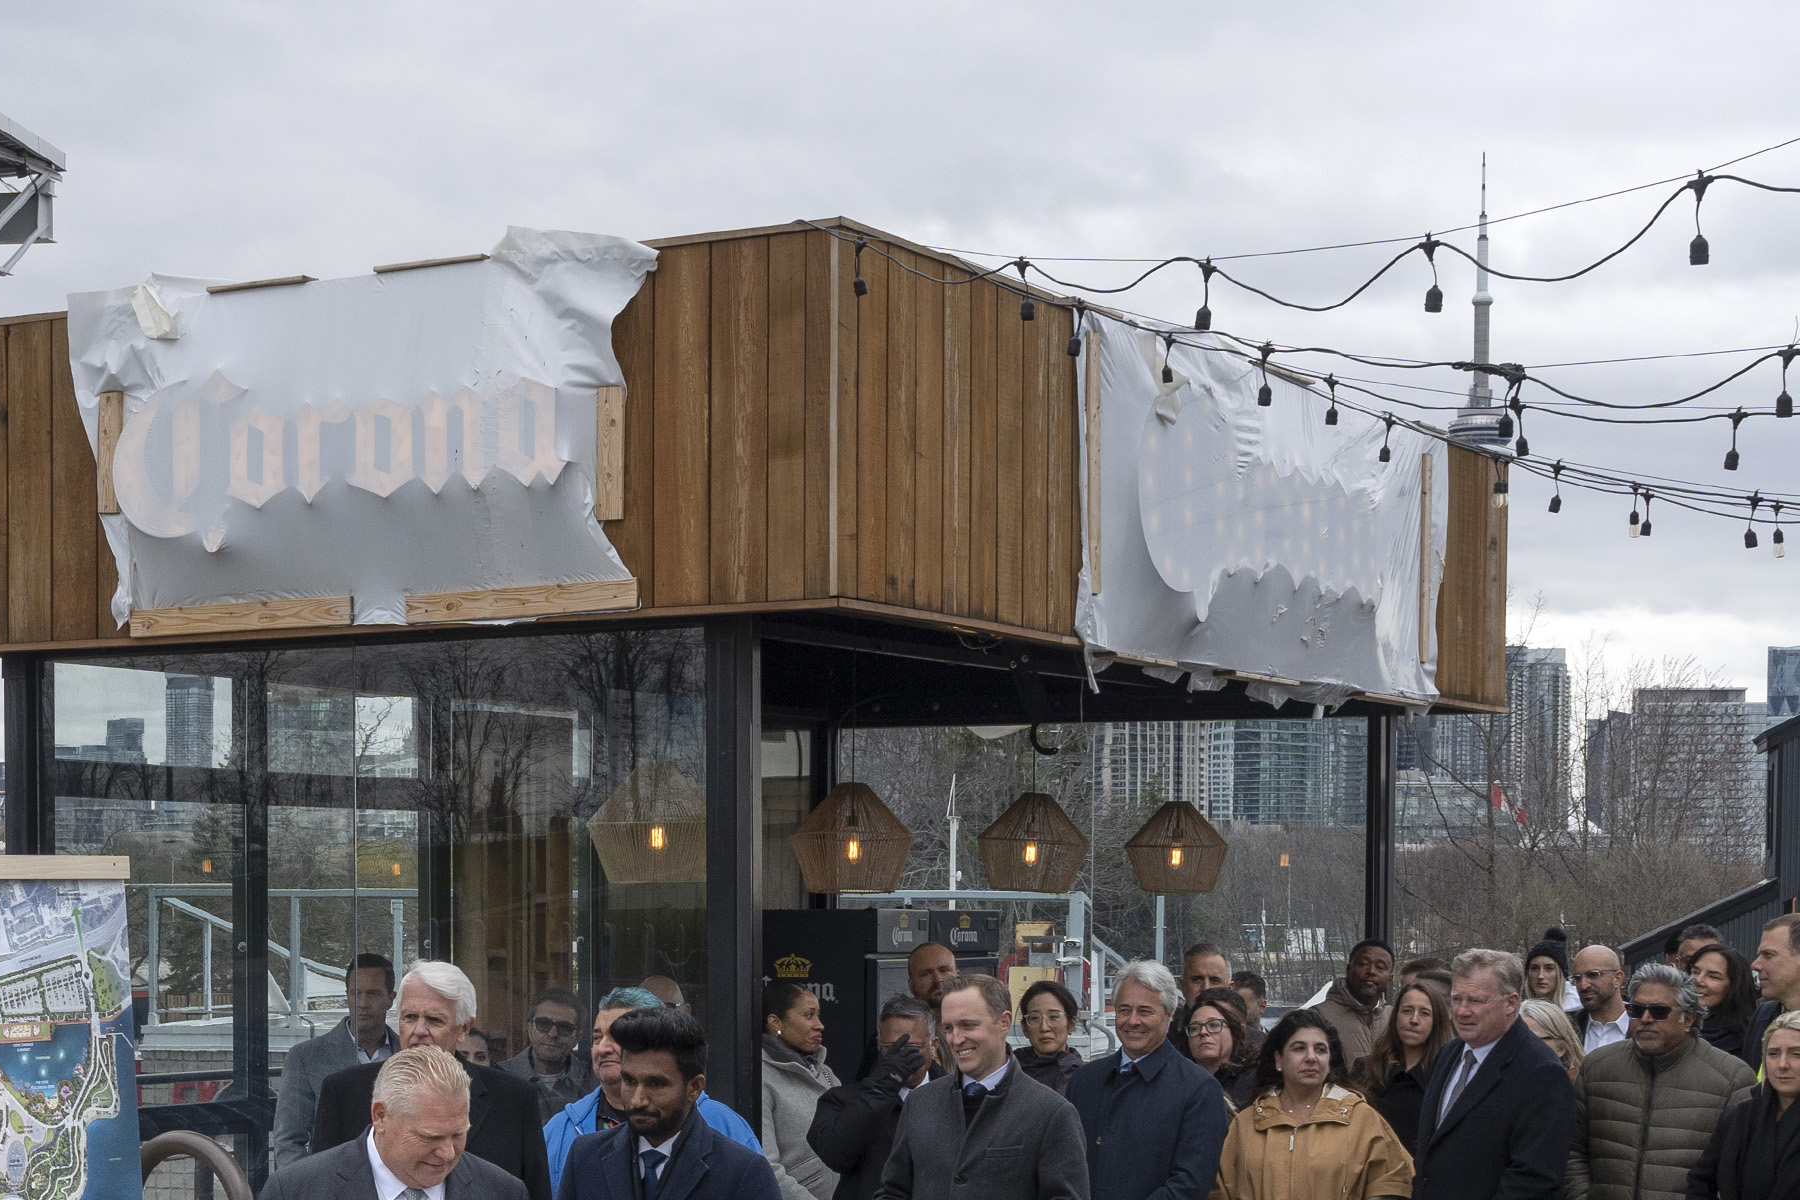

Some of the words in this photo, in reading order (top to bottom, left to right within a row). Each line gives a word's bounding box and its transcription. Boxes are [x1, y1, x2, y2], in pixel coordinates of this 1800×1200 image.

[113, 369, 574, 553] Corona
[891, 927, 913, 946] Corona
[950, 928, 978, 947] Corona
